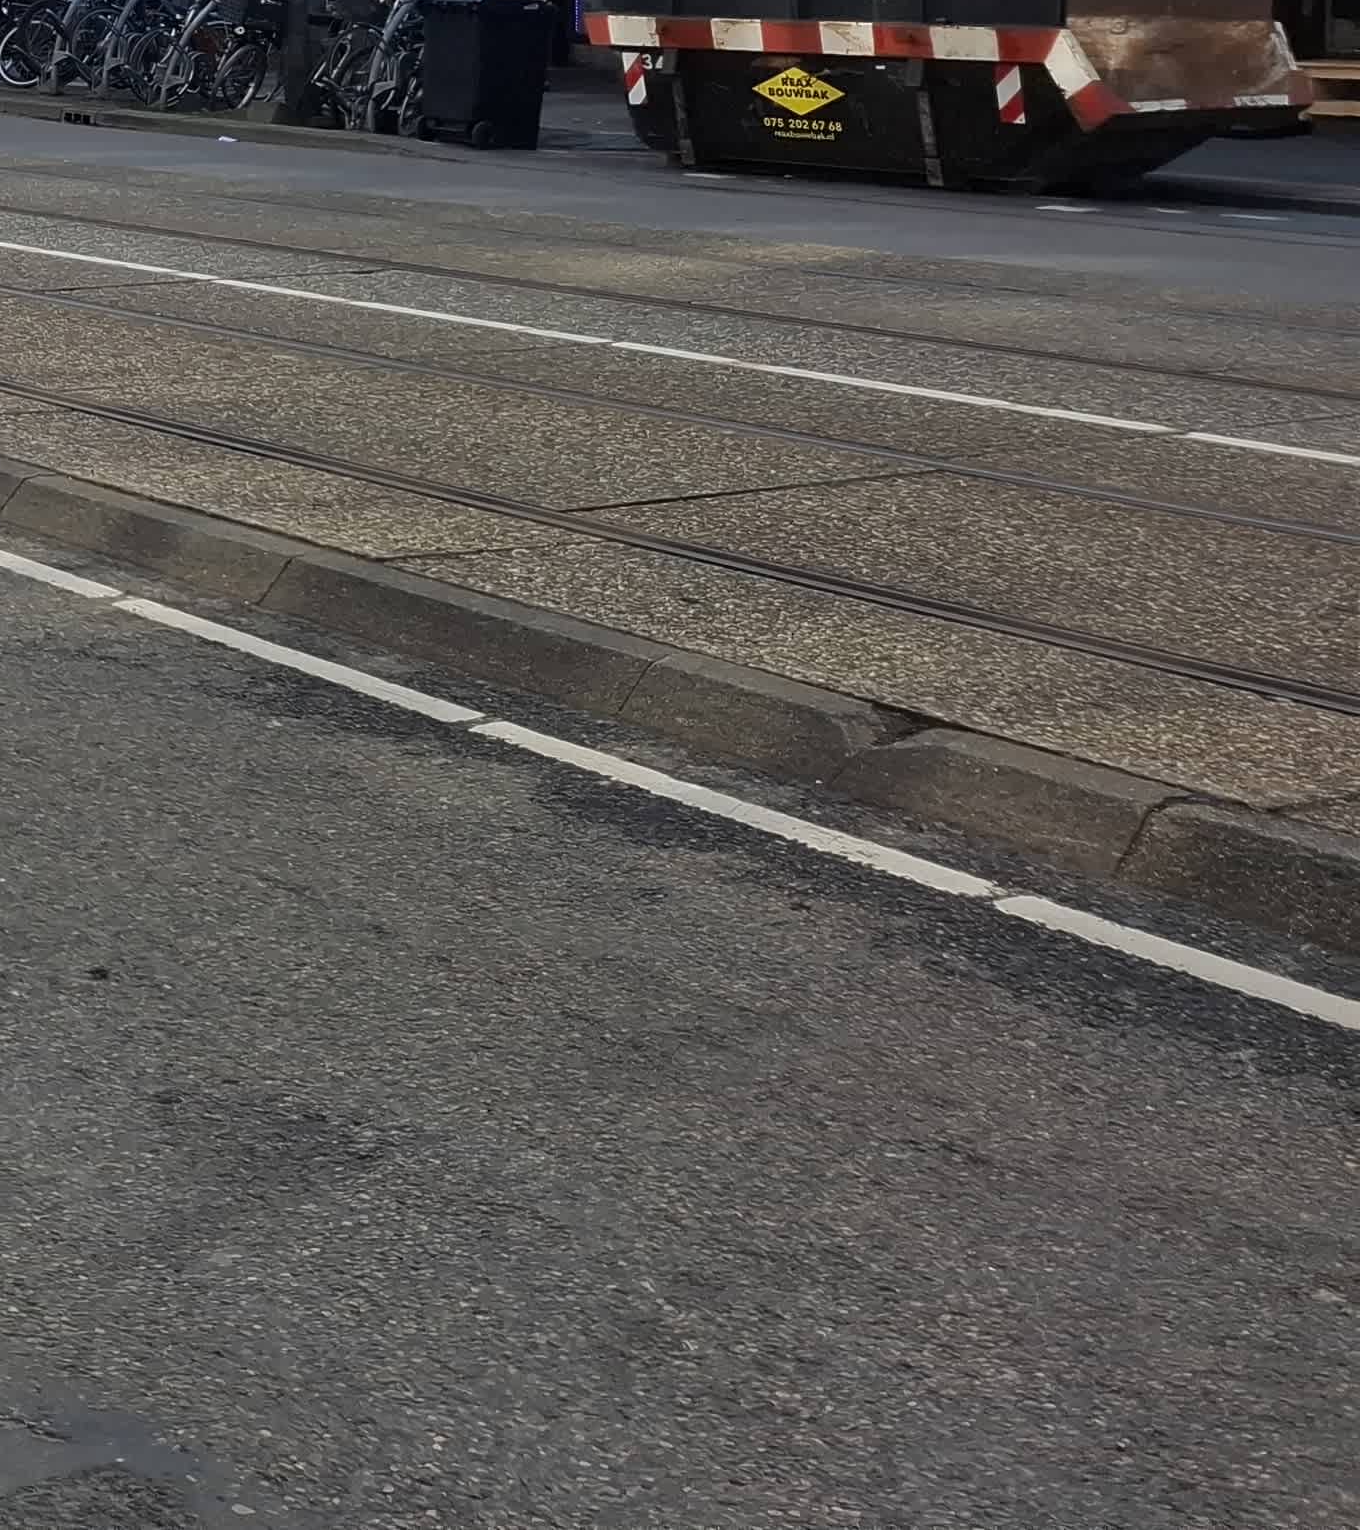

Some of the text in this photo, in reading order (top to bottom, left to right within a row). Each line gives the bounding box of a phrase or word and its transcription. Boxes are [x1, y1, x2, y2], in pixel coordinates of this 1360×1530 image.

[781, 77, 813, 88] REAX
[768, 87, 830, 100] BOUWBAK
[763, 117, 843, 132] 075 202 67 68
